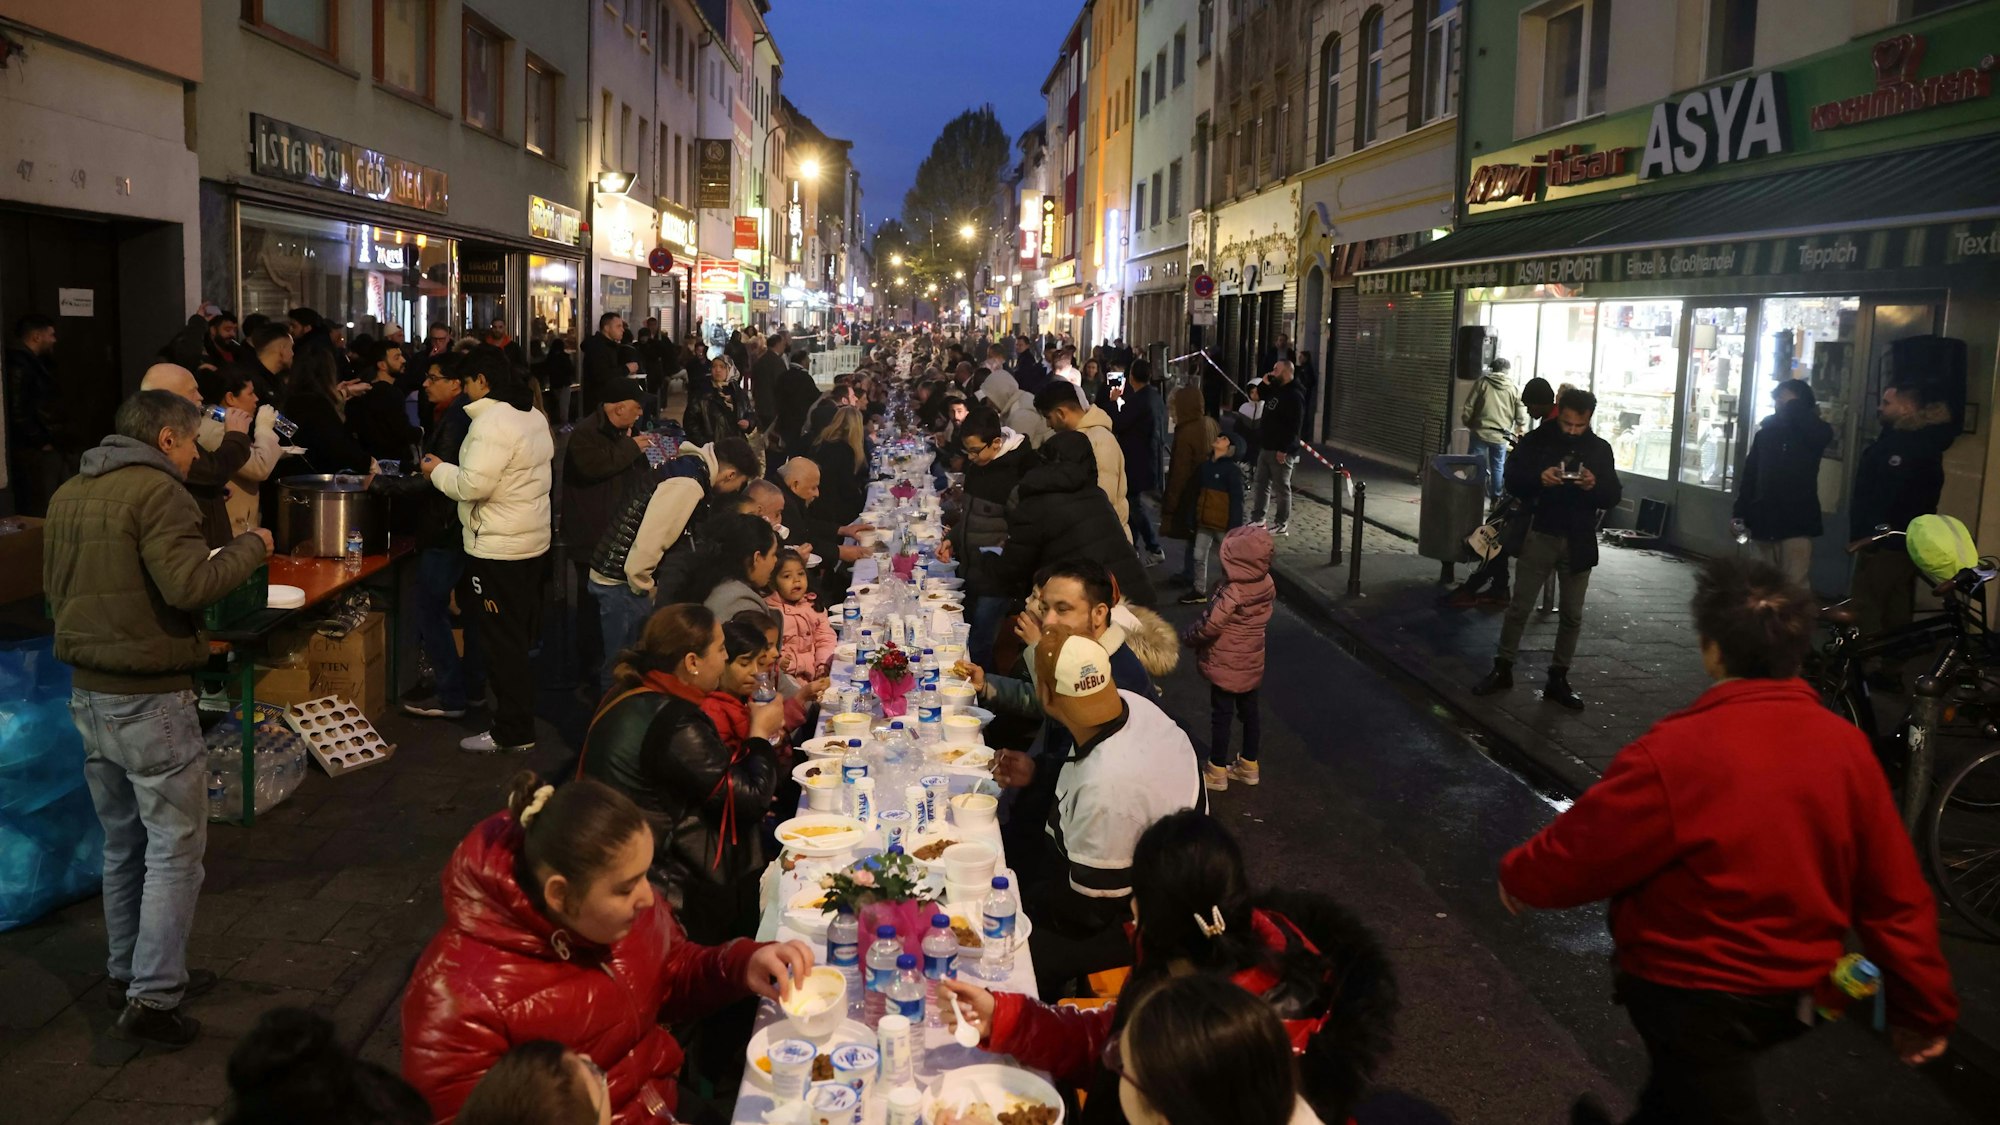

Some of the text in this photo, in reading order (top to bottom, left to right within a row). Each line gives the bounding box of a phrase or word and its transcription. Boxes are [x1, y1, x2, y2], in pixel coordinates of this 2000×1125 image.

[1639, 72, 1783, 180] ASYA
[16, 159, 131, 196] 47 49 51
[1627, 250, 1736, 275] Einzel & Großhandel
[1798, 241, 1857, 271] Teppich
[1518, 257, 1602, 284] ASYA EXPORT
[755, 283, 766, 298] P
[1073, 674, 1105, 692] PUEBLO
